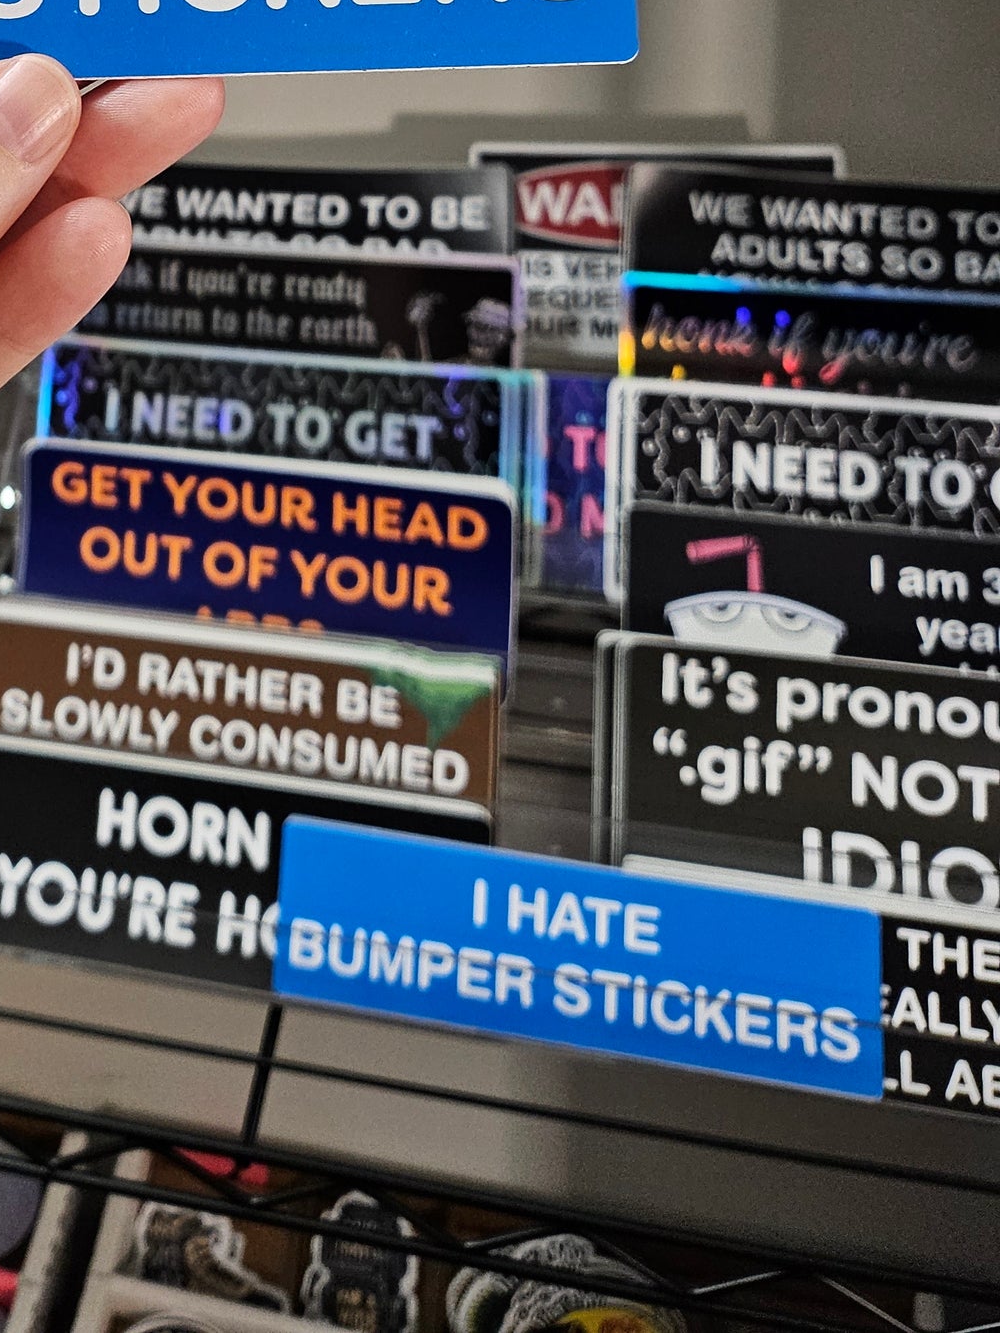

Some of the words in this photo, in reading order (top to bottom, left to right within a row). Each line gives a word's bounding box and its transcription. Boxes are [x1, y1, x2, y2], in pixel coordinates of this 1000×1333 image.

[176, 185, 351, 228] WANTED
[360, 194, 421, 230] TO
[430, 194, 489, 231] BE
[688, 190, 752, 228] WE
[760, 196, 941, 241] WANTED
[950, 209, 1000, 247] TO
[283, 270, 368, 310] ready
[710, 231, 874, 278] ADULTS
[880, 244, 946, 282] SO
[300, 311, 381, 349] earth
[104, 386, 120, 434] I
[130, 389, 256, 445] NEED
[266, 398, 333, 452] TO
[344, 408, 442, 464] GET
[52, 461, 152, 512] GET
[163, 470, 319, 534] YOUR
[331, 490, 490, 553] HEAD
[699, 432, 719, 488] I
[731, 439, 882, 502] NEED
[896, 455, 977, 509] TO
[79, 524, 194, 583] OUT
[202, 539, 280, 593] OF
[288, 546, 454, 618] YOUR
[870, 554, 886, 596] I
[898, 565, 970, 603] am
[65, 641, 127, 691] I'D
[138, 650, 326, 721] RATHER
[336, 676, 404, 730] BE
[660, 651, 761, 715] It's
[0, 687, 180, 754] SLOWLY
[187, 714, 471, 797] CONSUMED
[850, 750, 1000, 823] NOT
[96, 786, 273, 873] HORN
[472, 877, 489, 929] I
[506, 882, 662, 956] HATE
[288, 916, 535, 1010] BUMPER
[552, 961, 862, 1064] STICKERS
